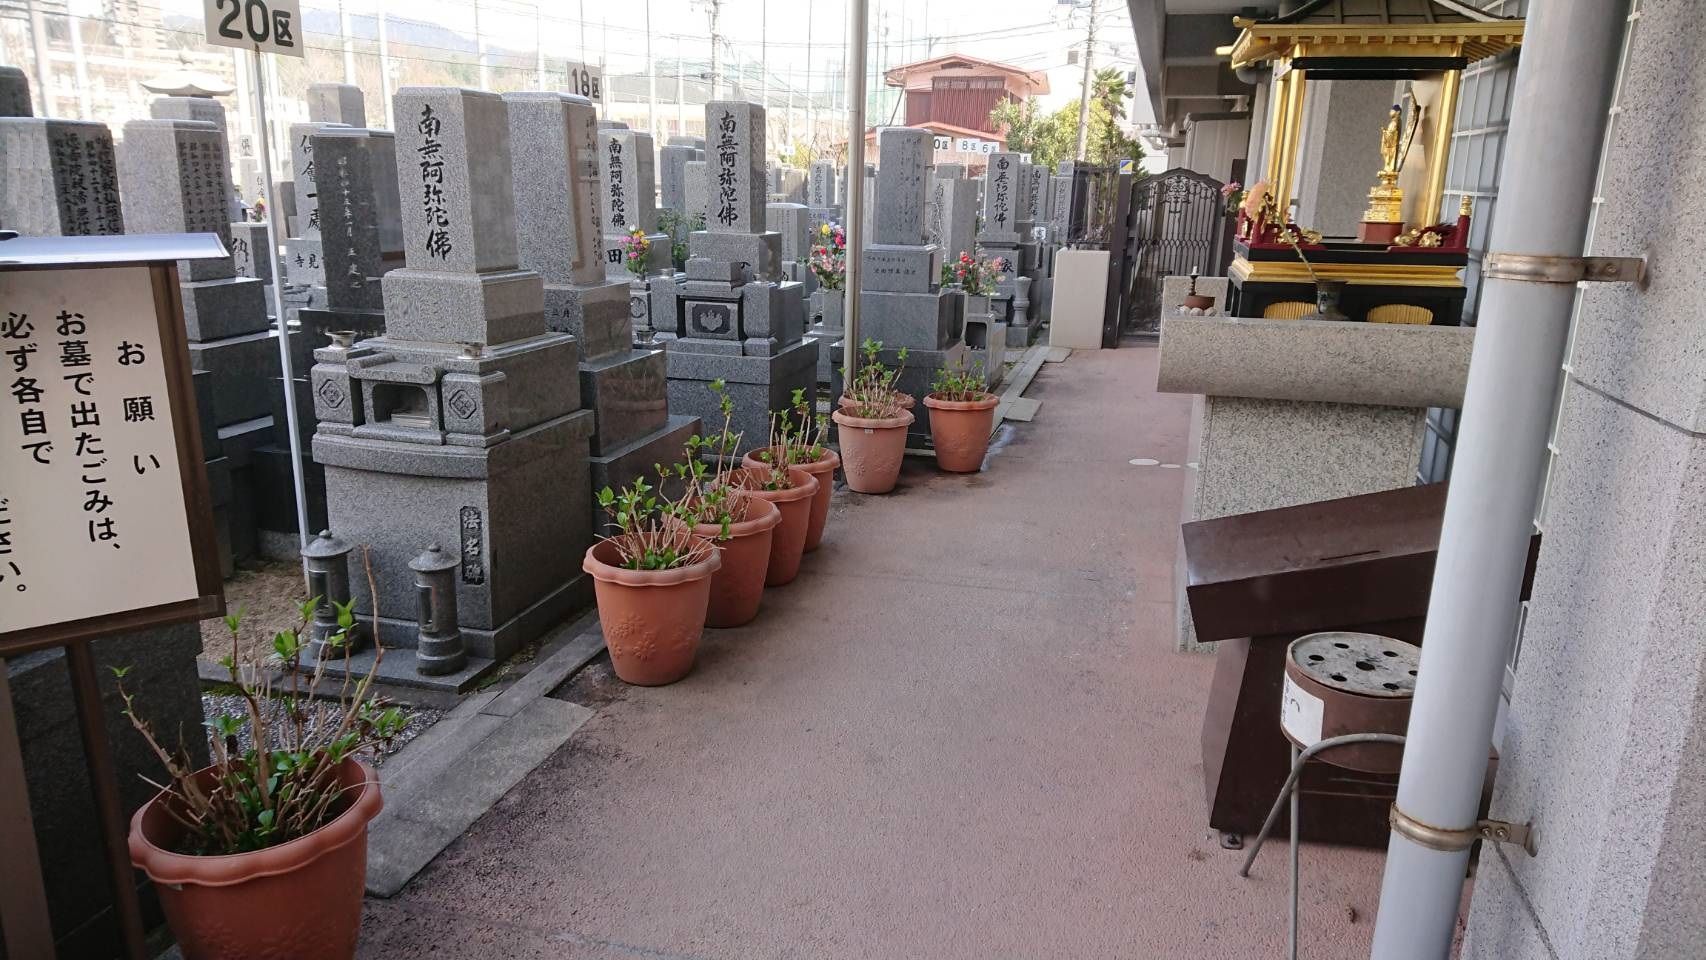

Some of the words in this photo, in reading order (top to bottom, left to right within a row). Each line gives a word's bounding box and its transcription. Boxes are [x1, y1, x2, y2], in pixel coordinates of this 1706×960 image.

[216, 0, 294, 48] 20区
[572, 67, 600, 99] 18区
[407, 104, 452, 261] 南無阿弥陀佛
[608, 137, 626, 229] 南無阿弥陀佛
[716, 110, 739, 227] 南無阿弥陀佛
[933, 138, 949, 150] 0区
[0, 312, 54, 464] 必ず各自で
[56, 310, 121, 549] お墓で出たごみは、
[117, 340, 161, 475] お願い
